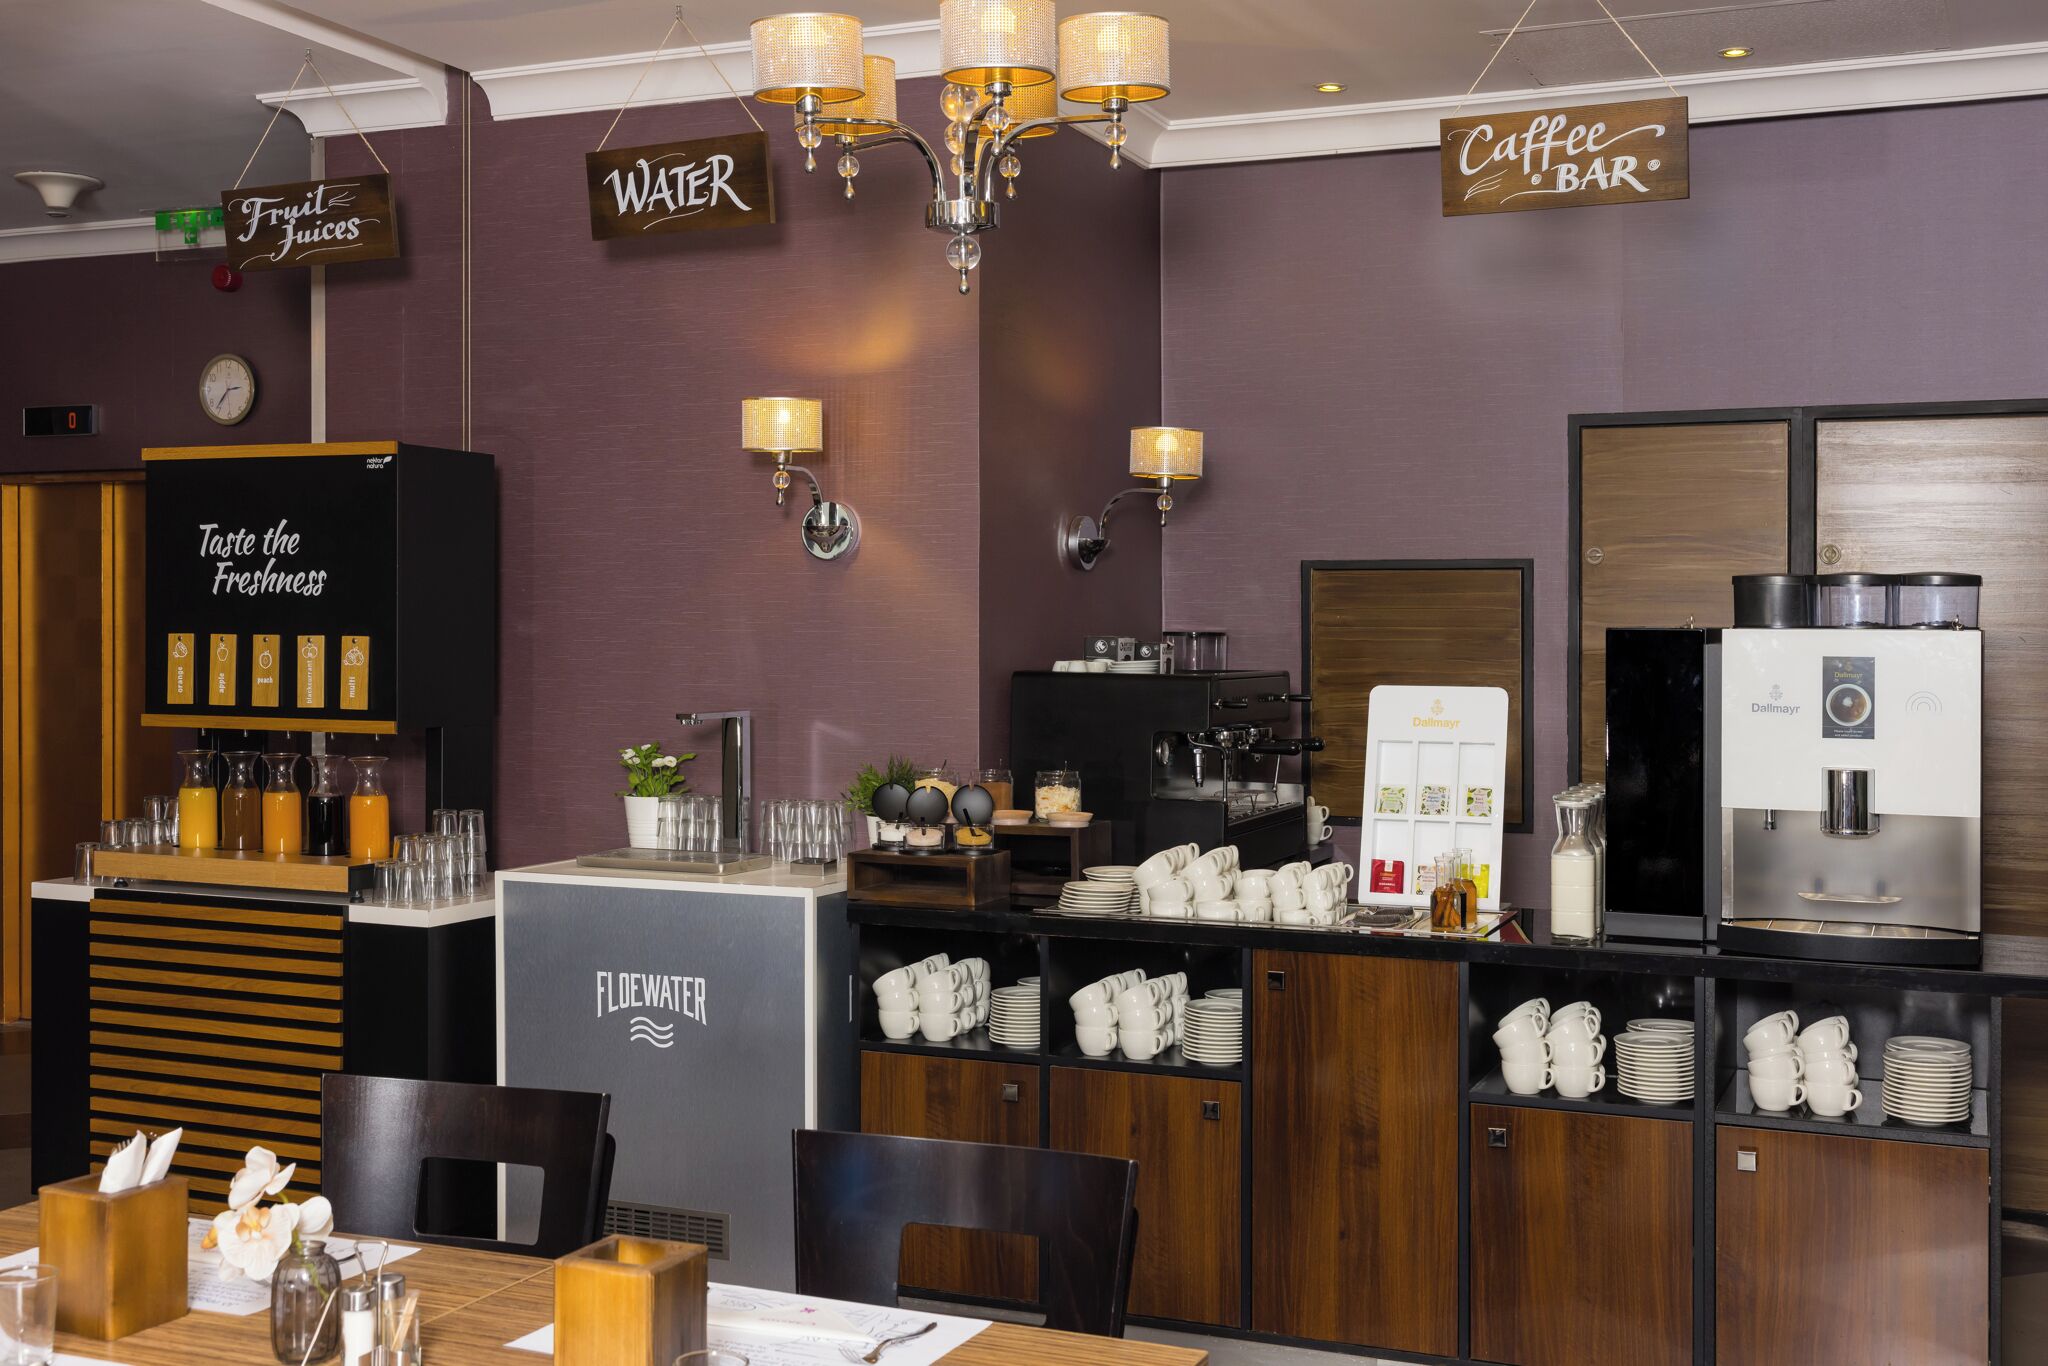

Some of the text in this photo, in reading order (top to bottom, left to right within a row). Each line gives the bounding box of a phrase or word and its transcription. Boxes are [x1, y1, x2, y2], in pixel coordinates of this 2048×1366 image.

[603, 153, 753, 217] WATER
[1552, 155, 1651, 193] BAR
[232, 184, 345, 242] Fruit
[268, 217, 370, 262] Juices
[69, 412, 77, 429] 0
[199, 518, 301, 558] Taste the
[212, 557, 327, 596] Freshness
[177, 666, 185, 694] orange
[218, 672, 227, 694] apple
[256, 676, 273, 684] peach
[305, 660, 314, 705] blackcurrant
[348, 676, 357, 699] multi
[1834, 671, 1863, 679] Dallmayr
[1412, 717, 1460, 729] Dallmayr
[1751, 703, 1800, 715] Dallmayr
[597, 970, 707, 1026] FLOEWATER
